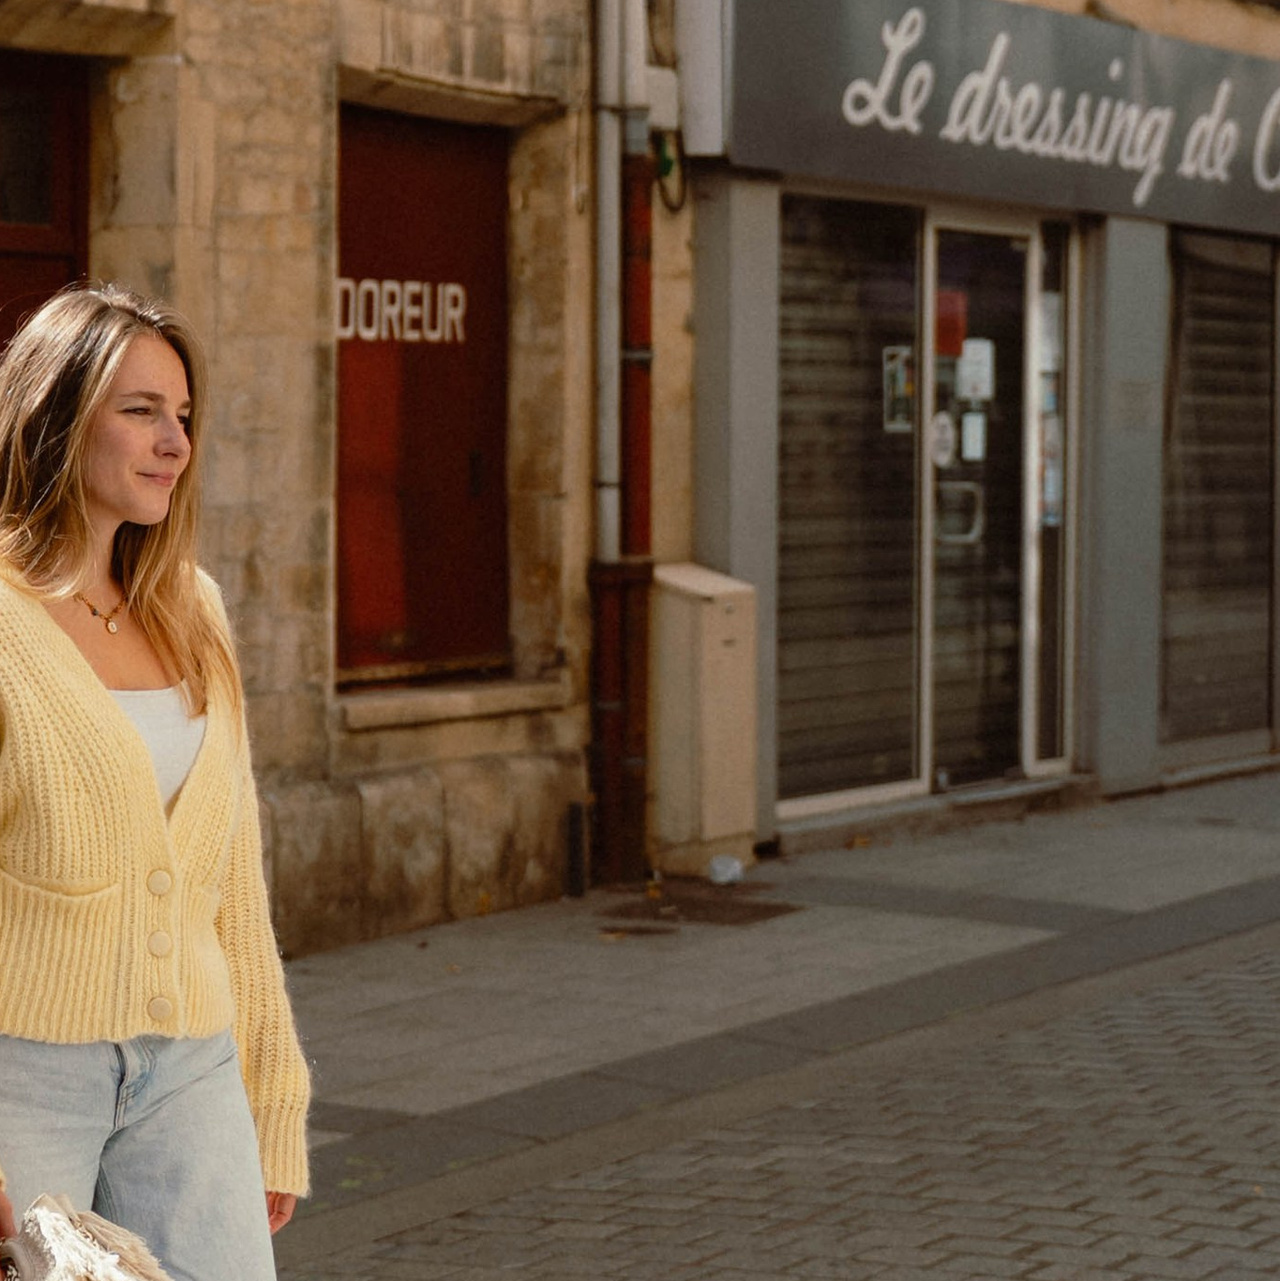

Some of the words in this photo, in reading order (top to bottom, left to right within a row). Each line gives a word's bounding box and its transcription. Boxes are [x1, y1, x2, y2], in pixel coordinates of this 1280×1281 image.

[842, 7, 935, 134] Le
[939, 32, 1175, 207] dressing
[1178, 78, 1240, 182] de
[336, 277, 467, 343] DOREUR
